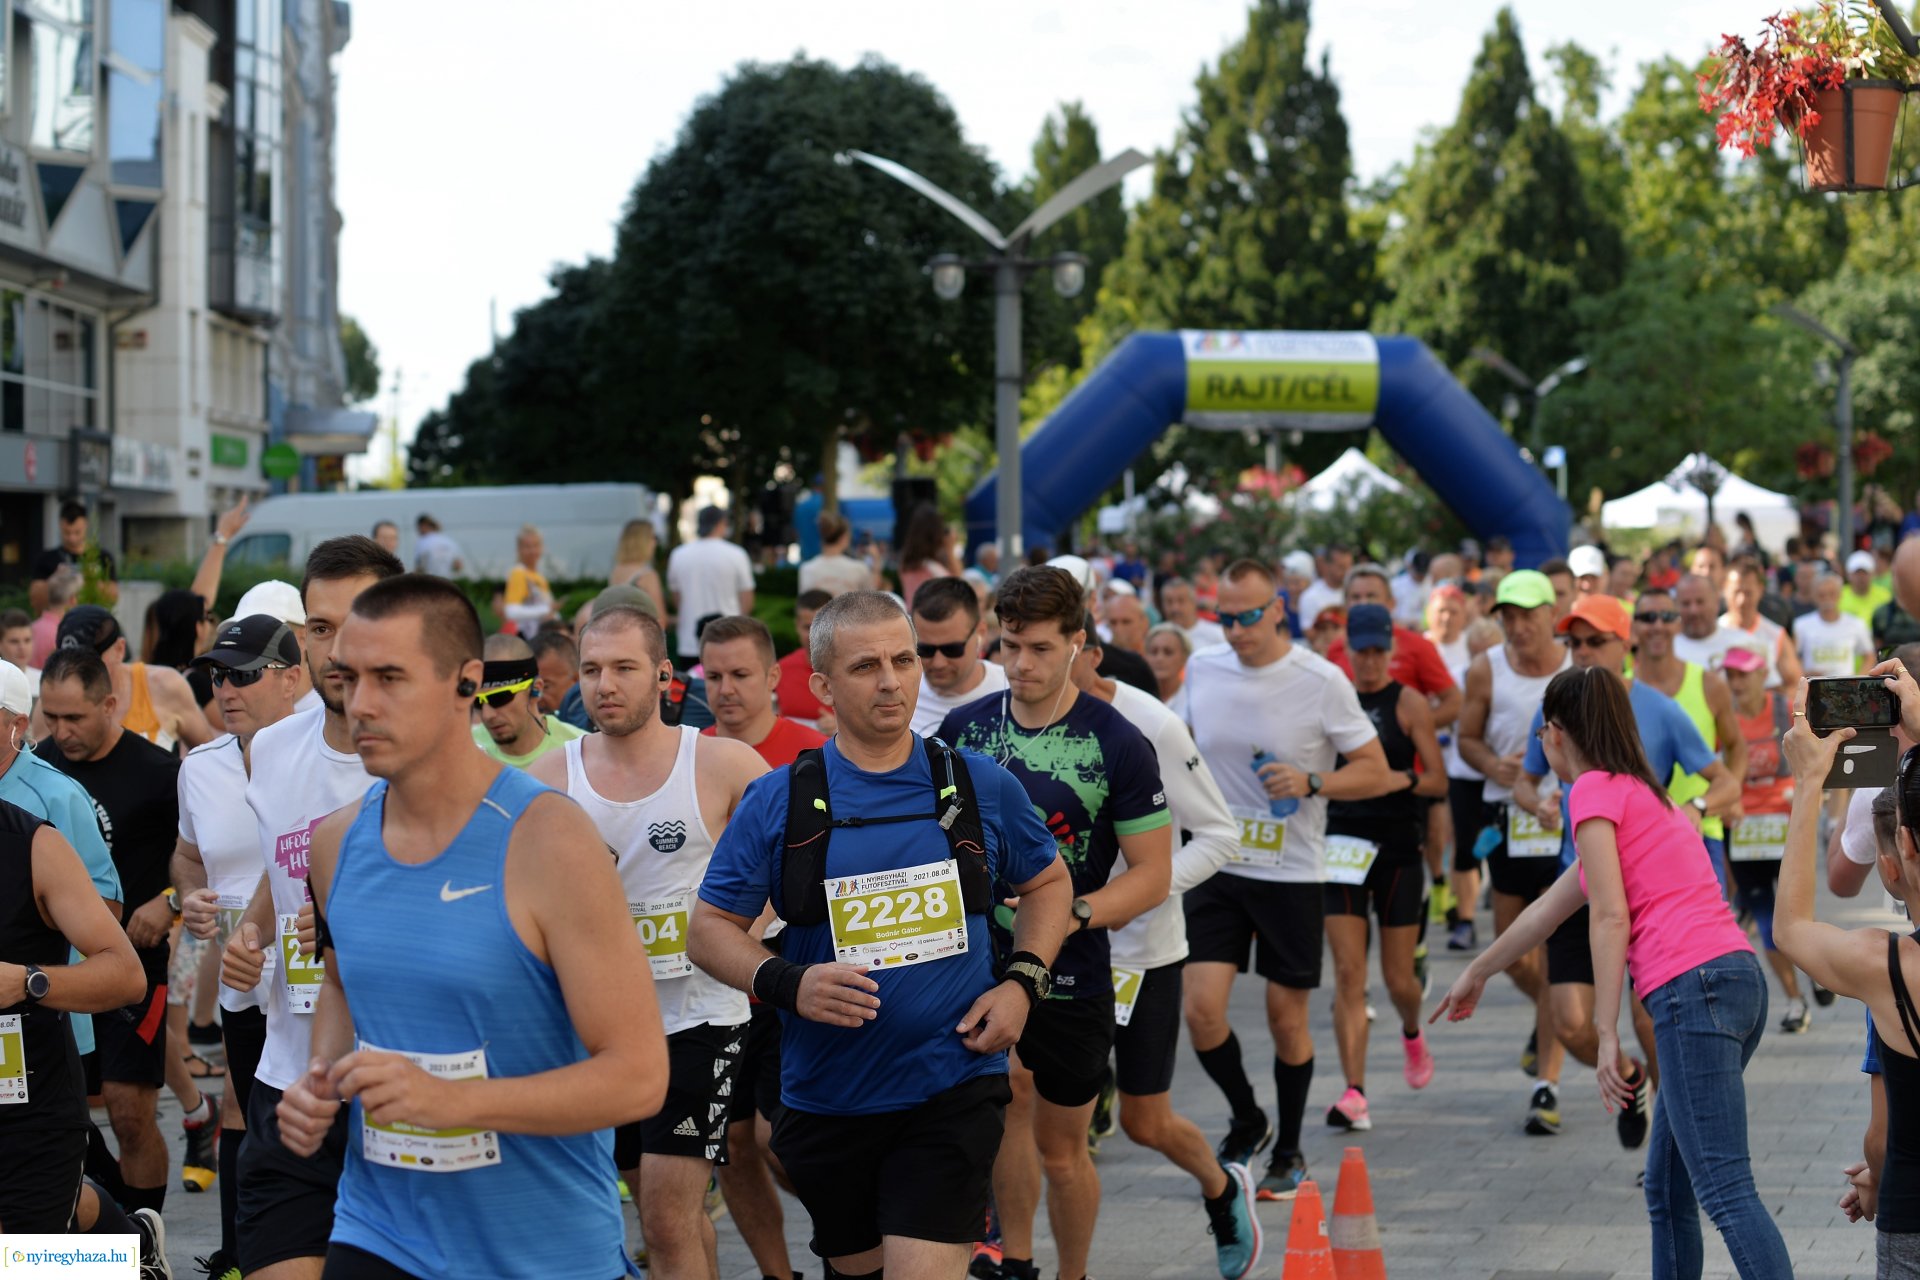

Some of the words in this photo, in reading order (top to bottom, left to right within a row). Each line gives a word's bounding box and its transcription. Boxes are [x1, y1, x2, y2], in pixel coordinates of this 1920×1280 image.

[1205, 368, 1357, 403] RAJT/CÉL
[843, 886, 949, 932] 2228
[636, 915, 680, 945] 04
[1056, 975, 1075, 986] 575
[1114, 970, 1132, 993] 7
[673, 1128, 700, 1137] adidas
